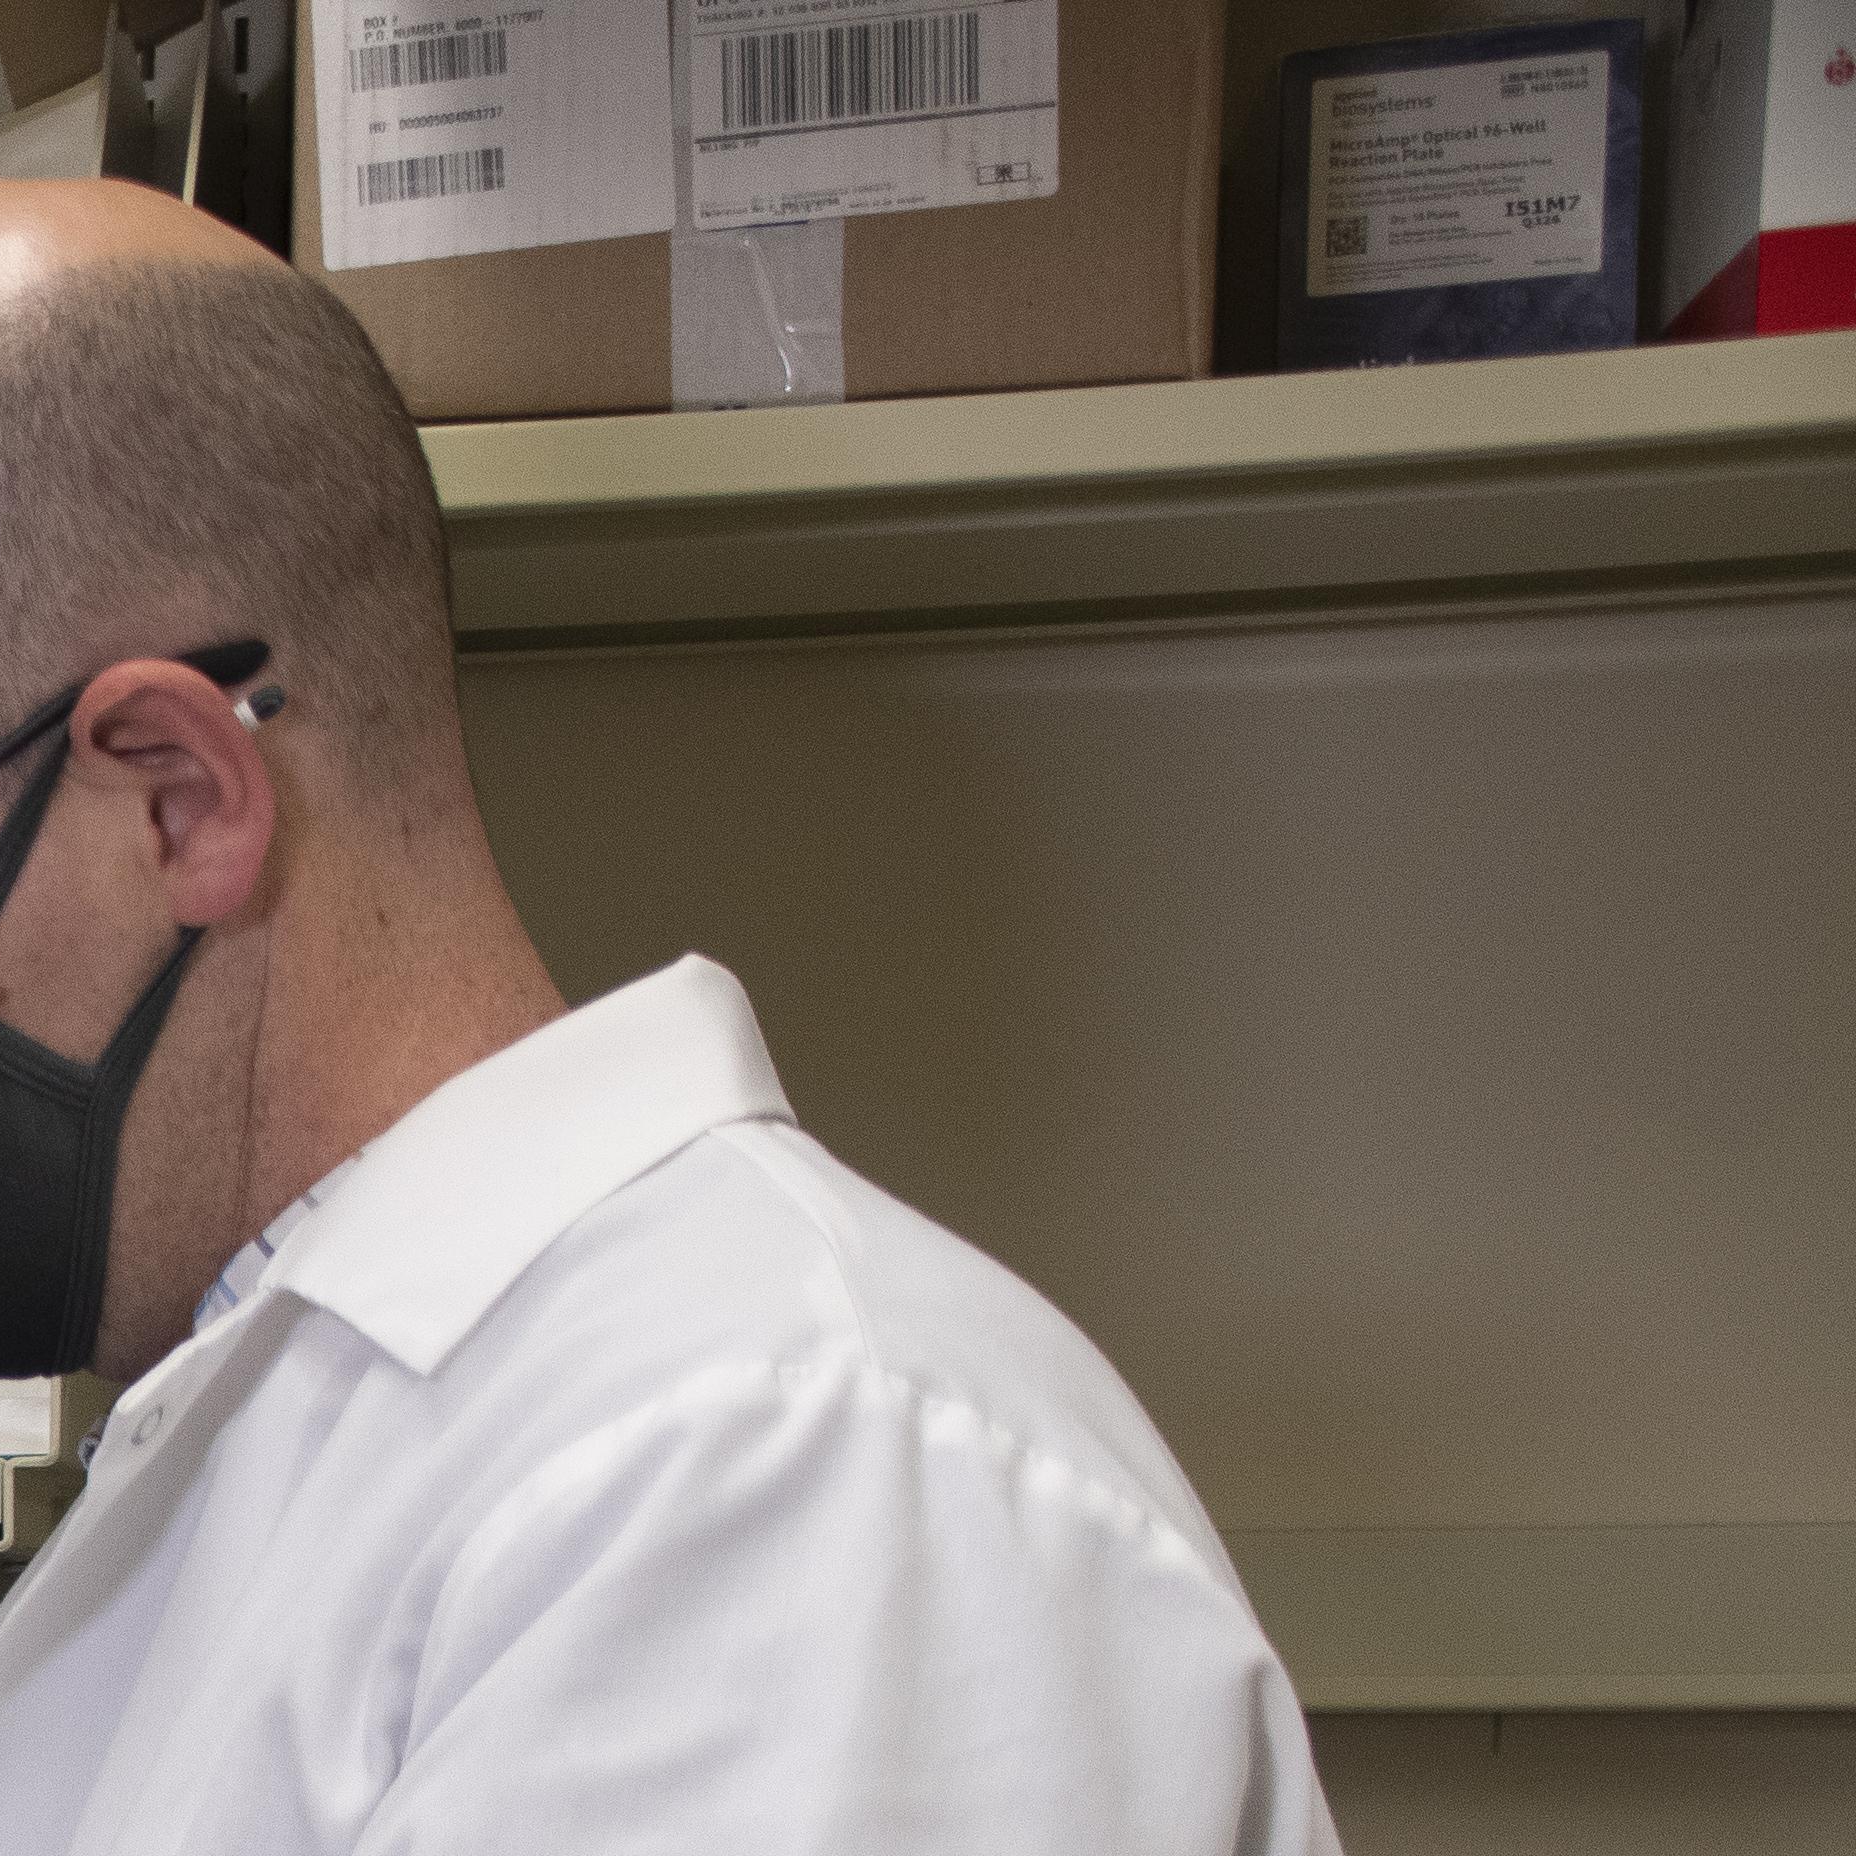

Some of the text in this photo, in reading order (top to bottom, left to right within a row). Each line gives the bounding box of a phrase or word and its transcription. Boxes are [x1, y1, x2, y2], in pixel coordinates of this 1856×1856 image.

[364, 15, 386, 29] BOX
[1423, 126, 1478, 145] Optical
[1329, 147, 1444, 169] Reaction Plate
